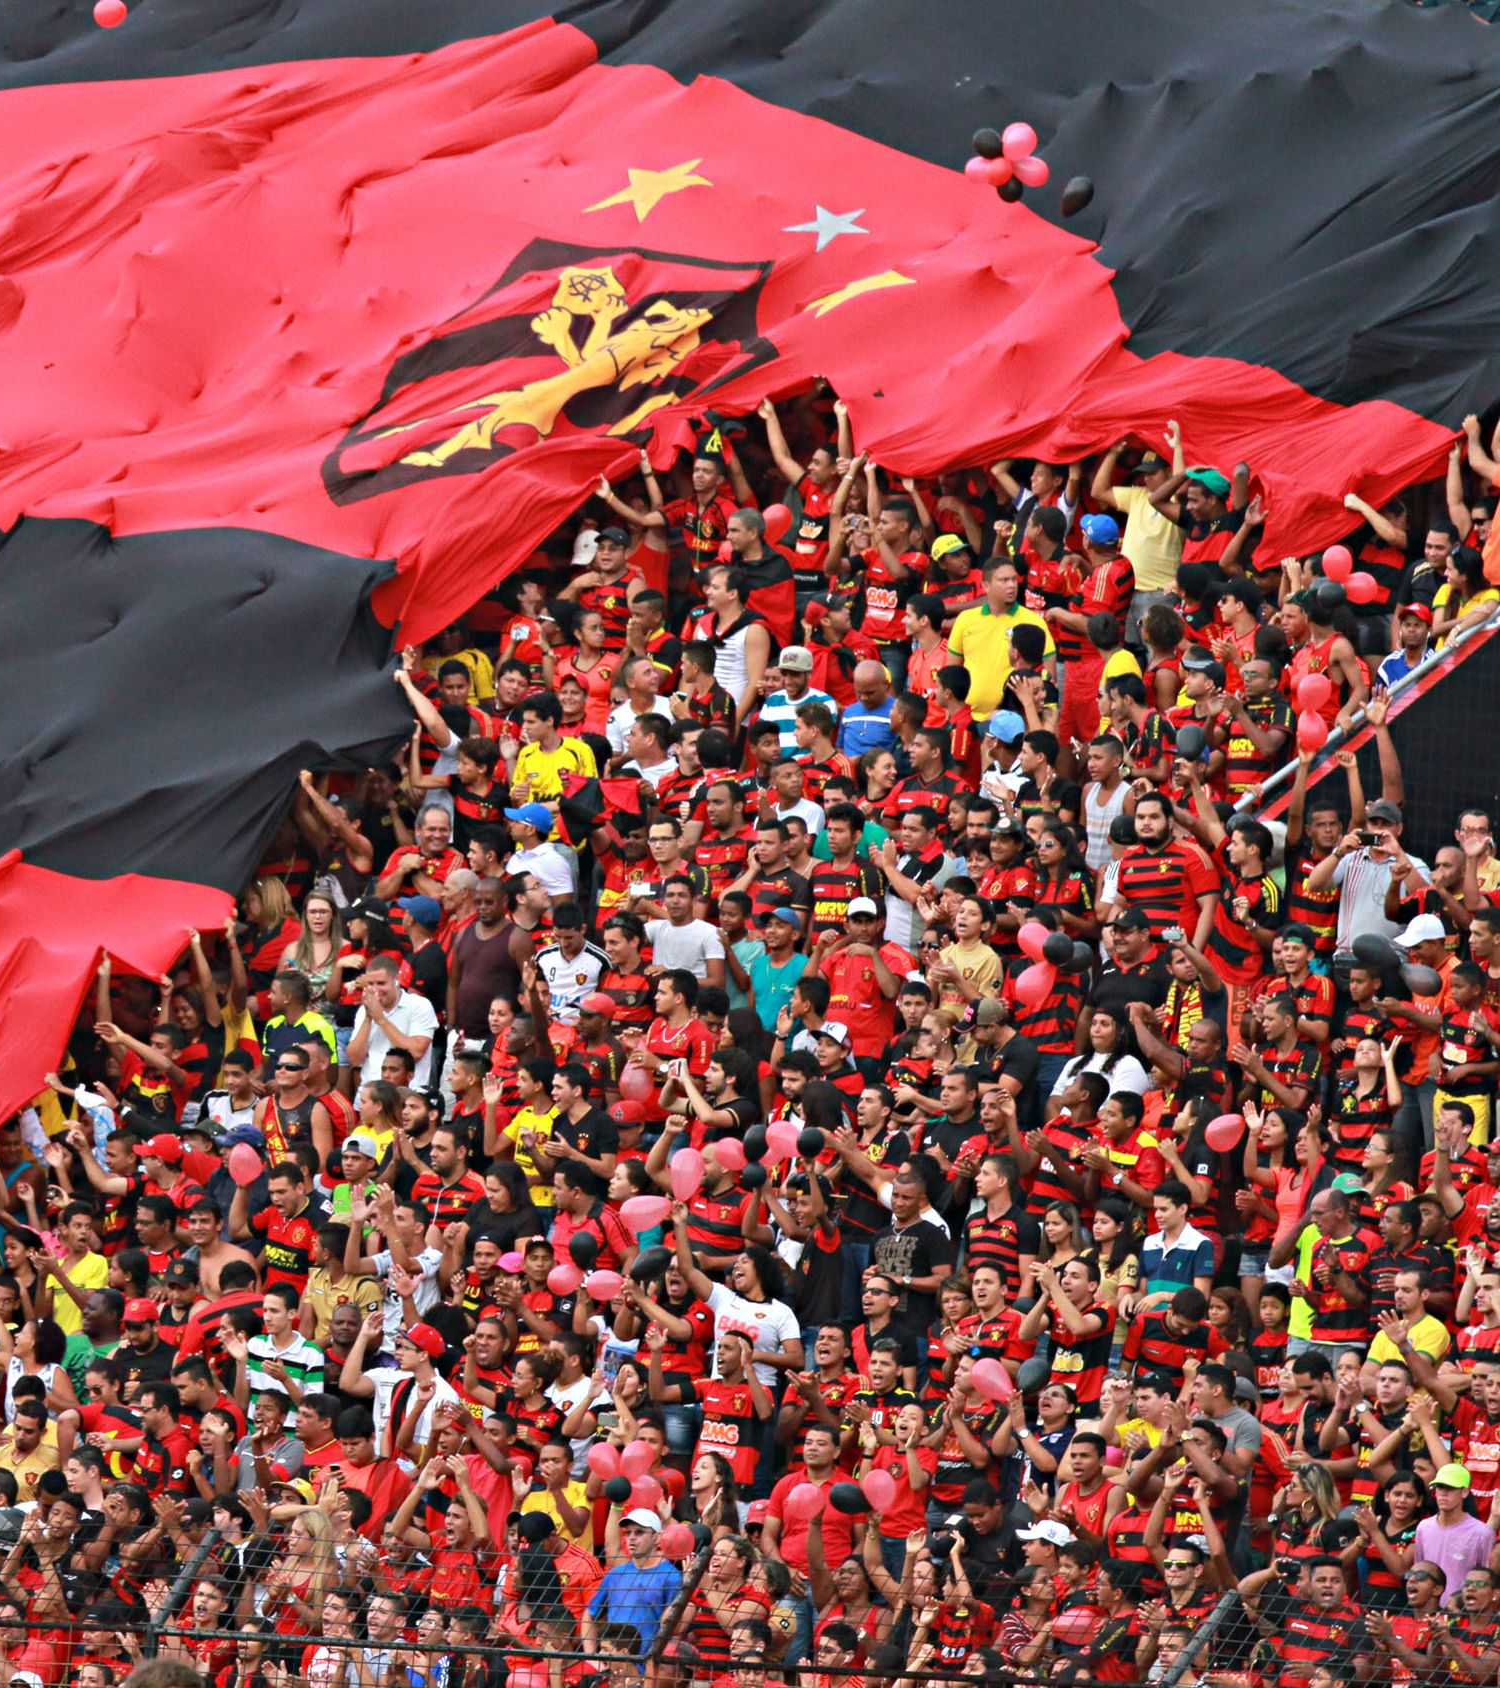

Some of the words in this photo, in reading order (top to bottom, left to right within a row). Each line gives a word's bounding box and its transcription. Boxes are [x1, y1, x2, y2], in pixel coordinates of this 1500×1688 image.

[864, 586, 897, 609] BMG
[814, 902, 848, 915] MRV
[548, 966, 557, 983] 9
[716, 1314, 760, 1342] BMG
[700, 1420, 738, 1445] BMG
